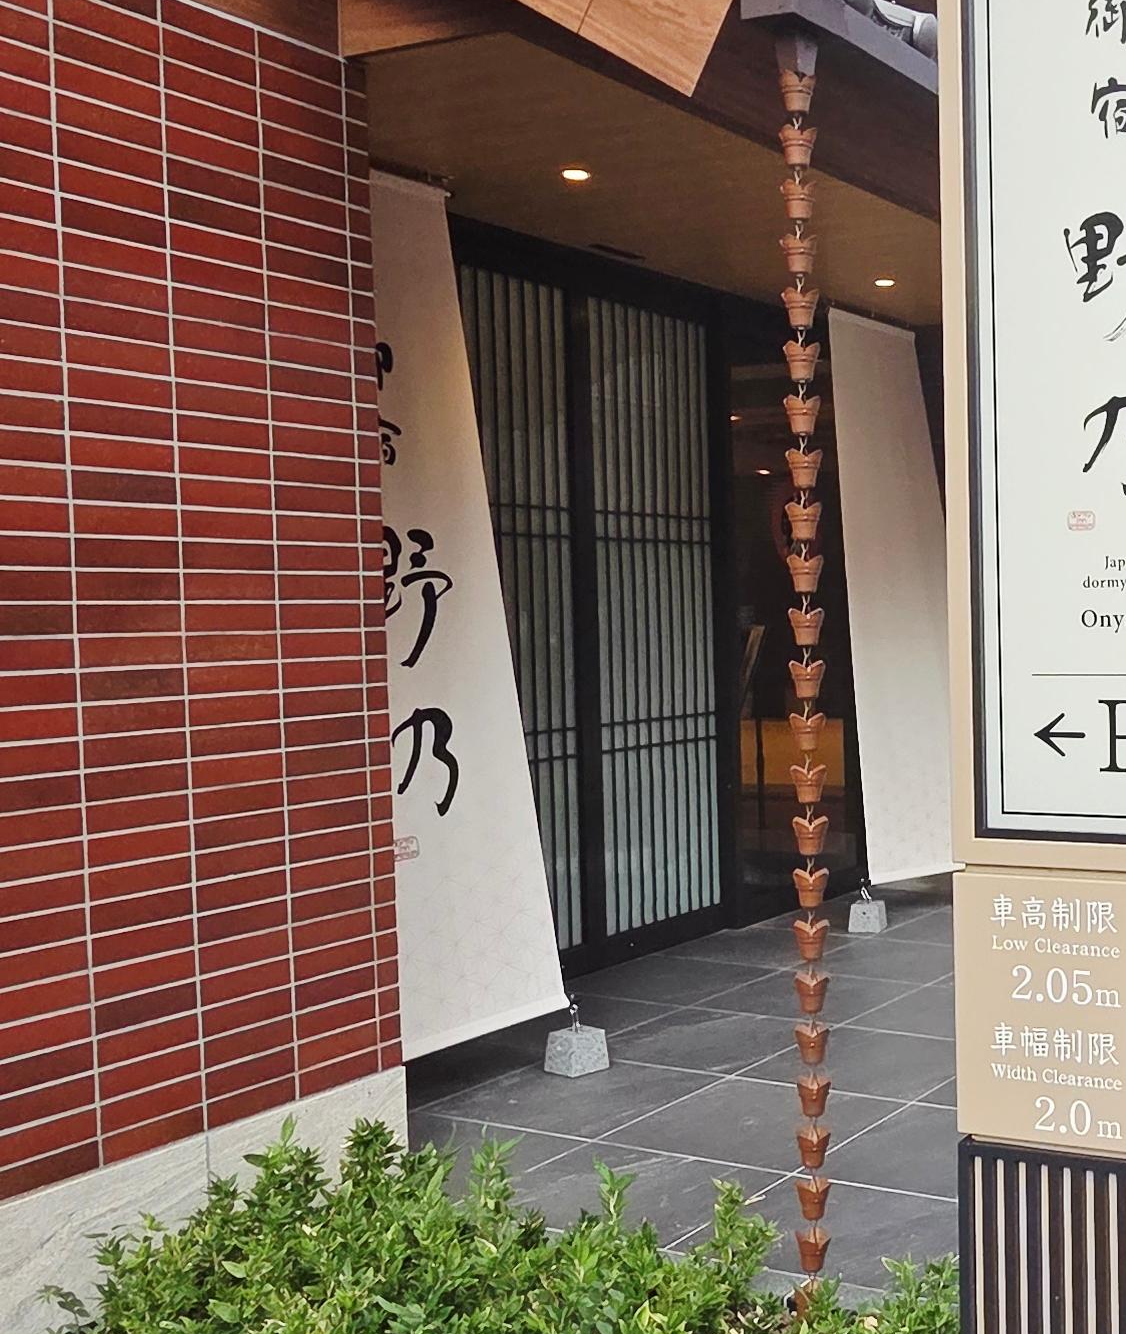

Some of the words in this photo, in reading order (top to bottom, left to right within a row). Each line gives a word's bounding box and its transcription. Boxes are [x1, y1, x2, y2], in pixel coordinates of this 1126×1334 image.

[1082, 575, 1126, 591] dormy
[990, 894, 1118, 933] 車高制限
[991, 934, 1027, 951] Low
[1034, 937, 1121, 959] Clearance
[1011, 964, 1122, 1008] 2.05m
[990, 1021, 1119, 1066] 車幅制限
[990, 1062, 1037, 1082] Width
[1042, 1068, 1123, 1092] Clearance
